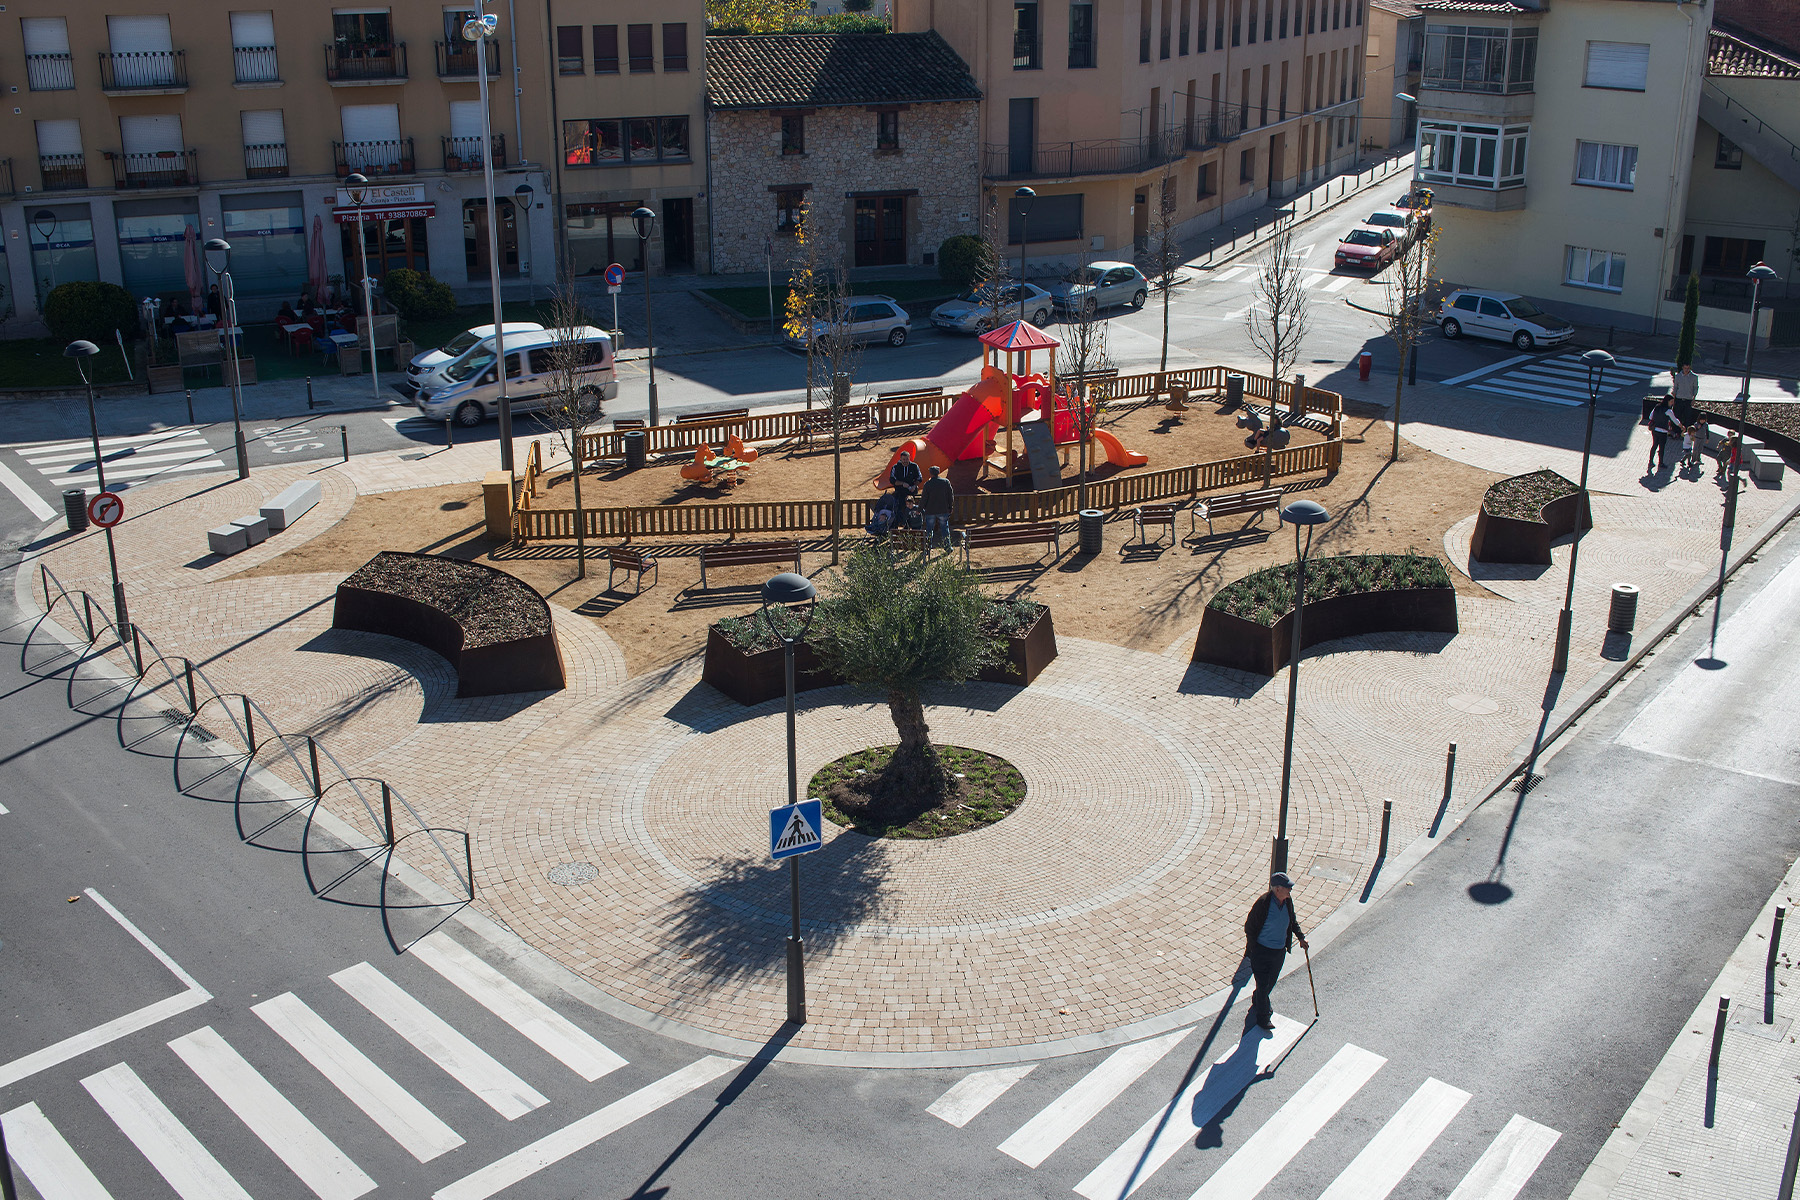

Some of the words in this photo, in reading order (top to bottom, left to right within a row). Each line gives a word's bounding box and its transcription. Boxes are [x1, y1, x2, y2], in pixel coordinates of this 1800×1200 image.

[372, 189, 380, 198] El
[383, 187, 414, 196] Castell
[388, 210, 428, 218] 938870862
[252, 426, 325, 454] STOP
